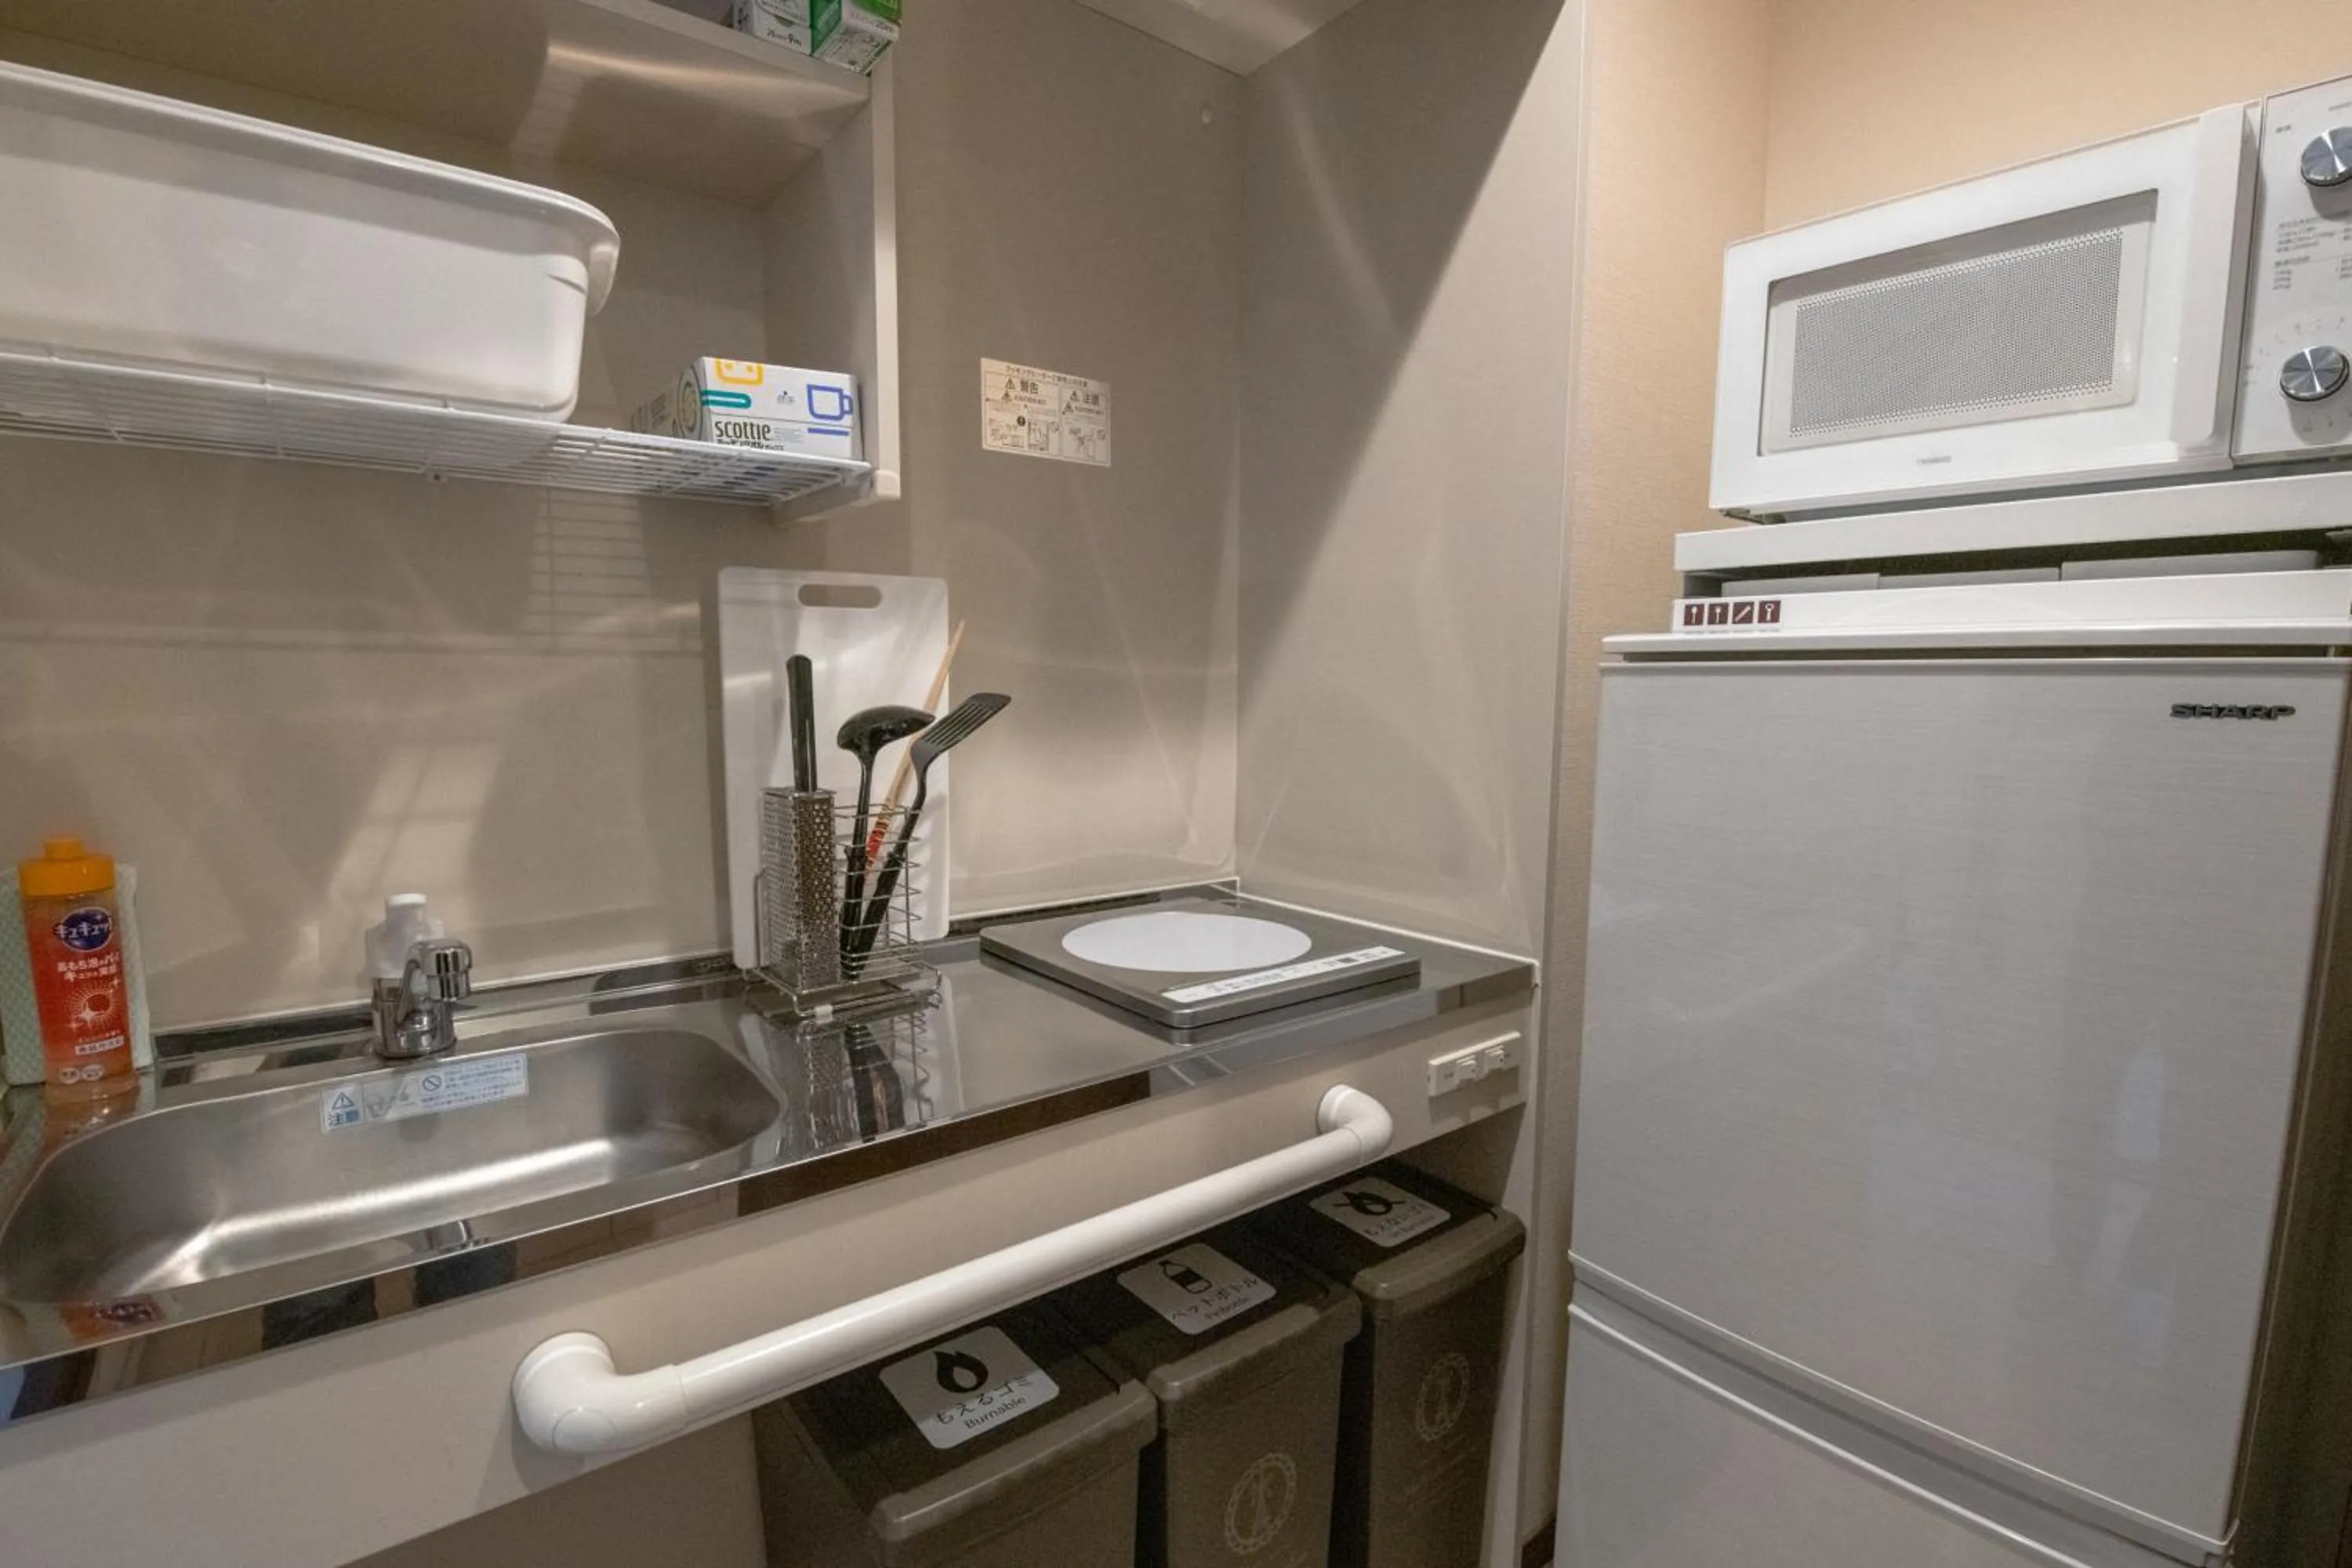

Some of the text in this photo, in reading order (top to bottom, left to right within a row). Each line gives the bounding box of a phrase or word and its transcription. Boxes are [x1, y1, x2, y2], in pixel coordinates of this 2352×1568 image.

[714, 421, 771, 441] scottie
[2170, 703, 2296, 720] SHARP
[327, 1109, 359, 1127] 注
[937, 1375, 1033, 1425] もえるゴミ
[964, 1396, 1029, 1429] Burnable
